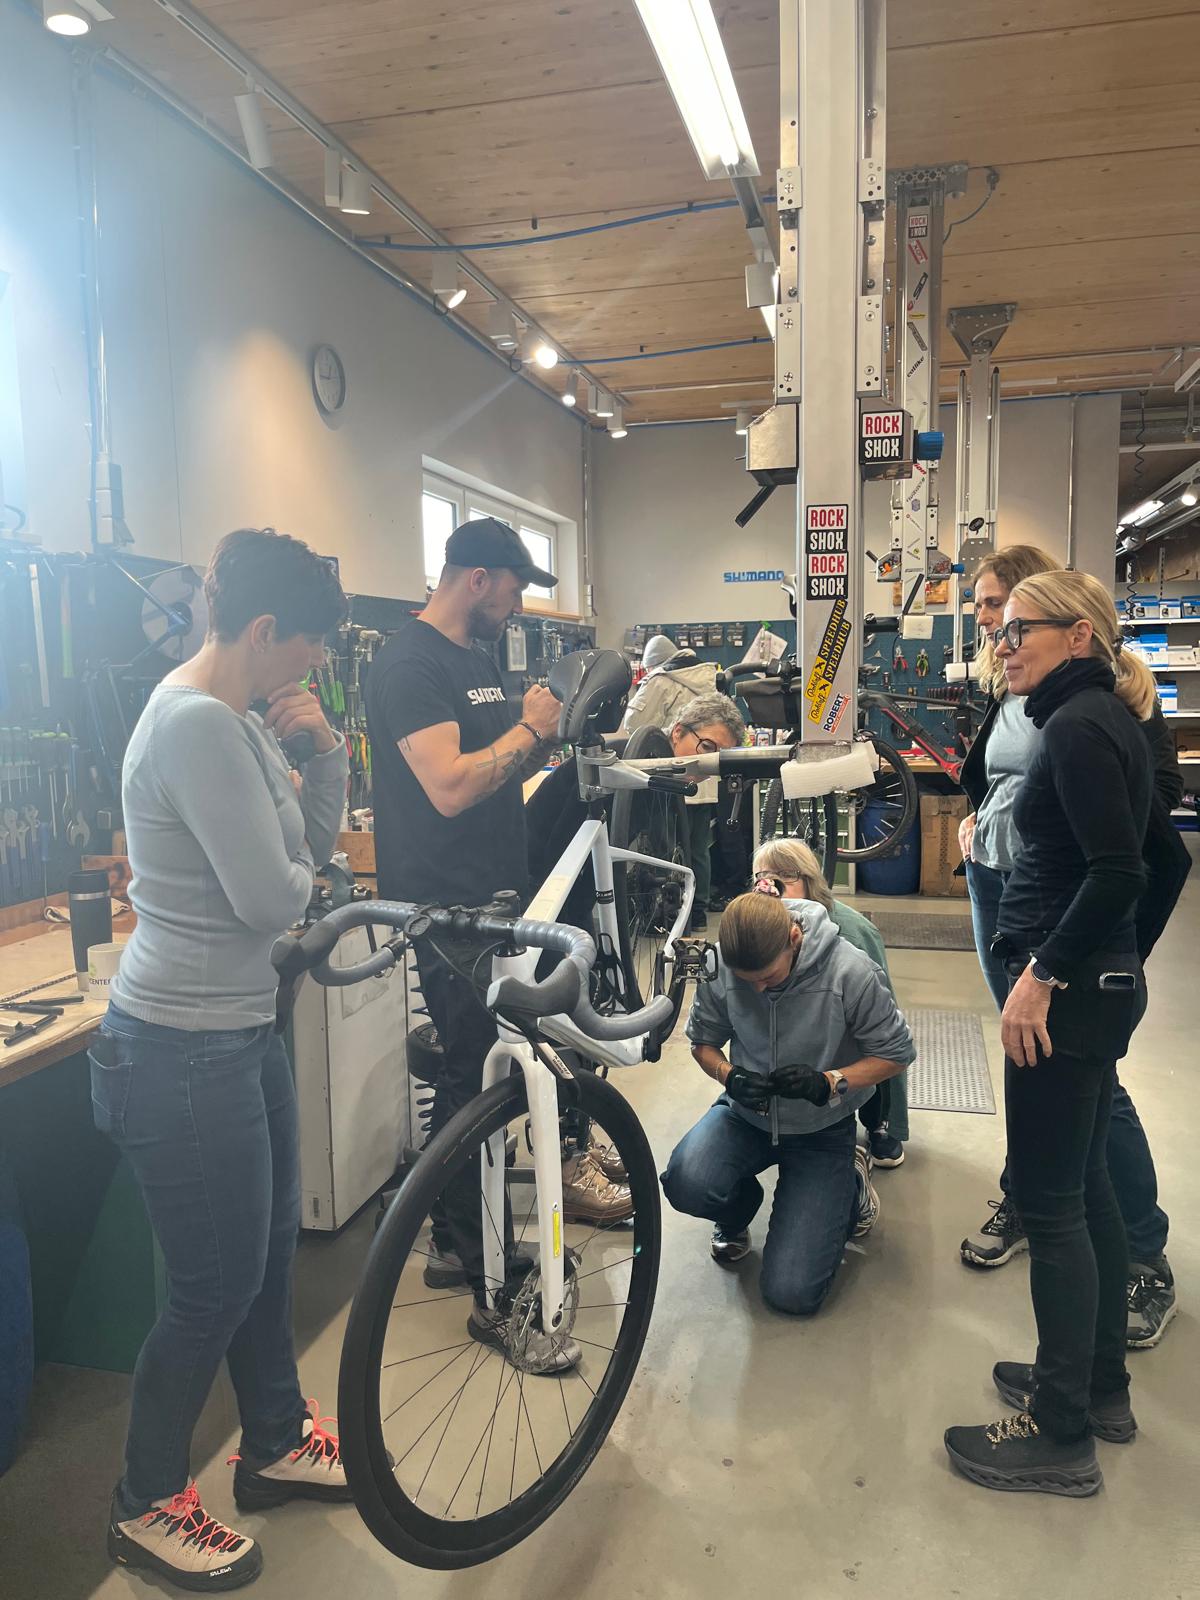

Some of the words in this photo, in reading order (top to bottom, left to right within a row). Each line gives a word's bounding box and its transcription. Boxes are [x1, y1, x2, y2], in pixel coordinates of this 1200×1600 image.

[865, 415, 900, 435] ROCK
[864, 438, 900, 458] SHOX
[810, 509, 844, 527] ROCK
[809, 532, 844, 550] SHOX
[811, 555, 845, 573] ROCK
[810, 577, 845, 596] SHOX
[820, 599, 846, 659] SPEEDHUB
[824, 621, 850, 680] SPEEDHUB
[824, 694, 844, 731] ROBERT
